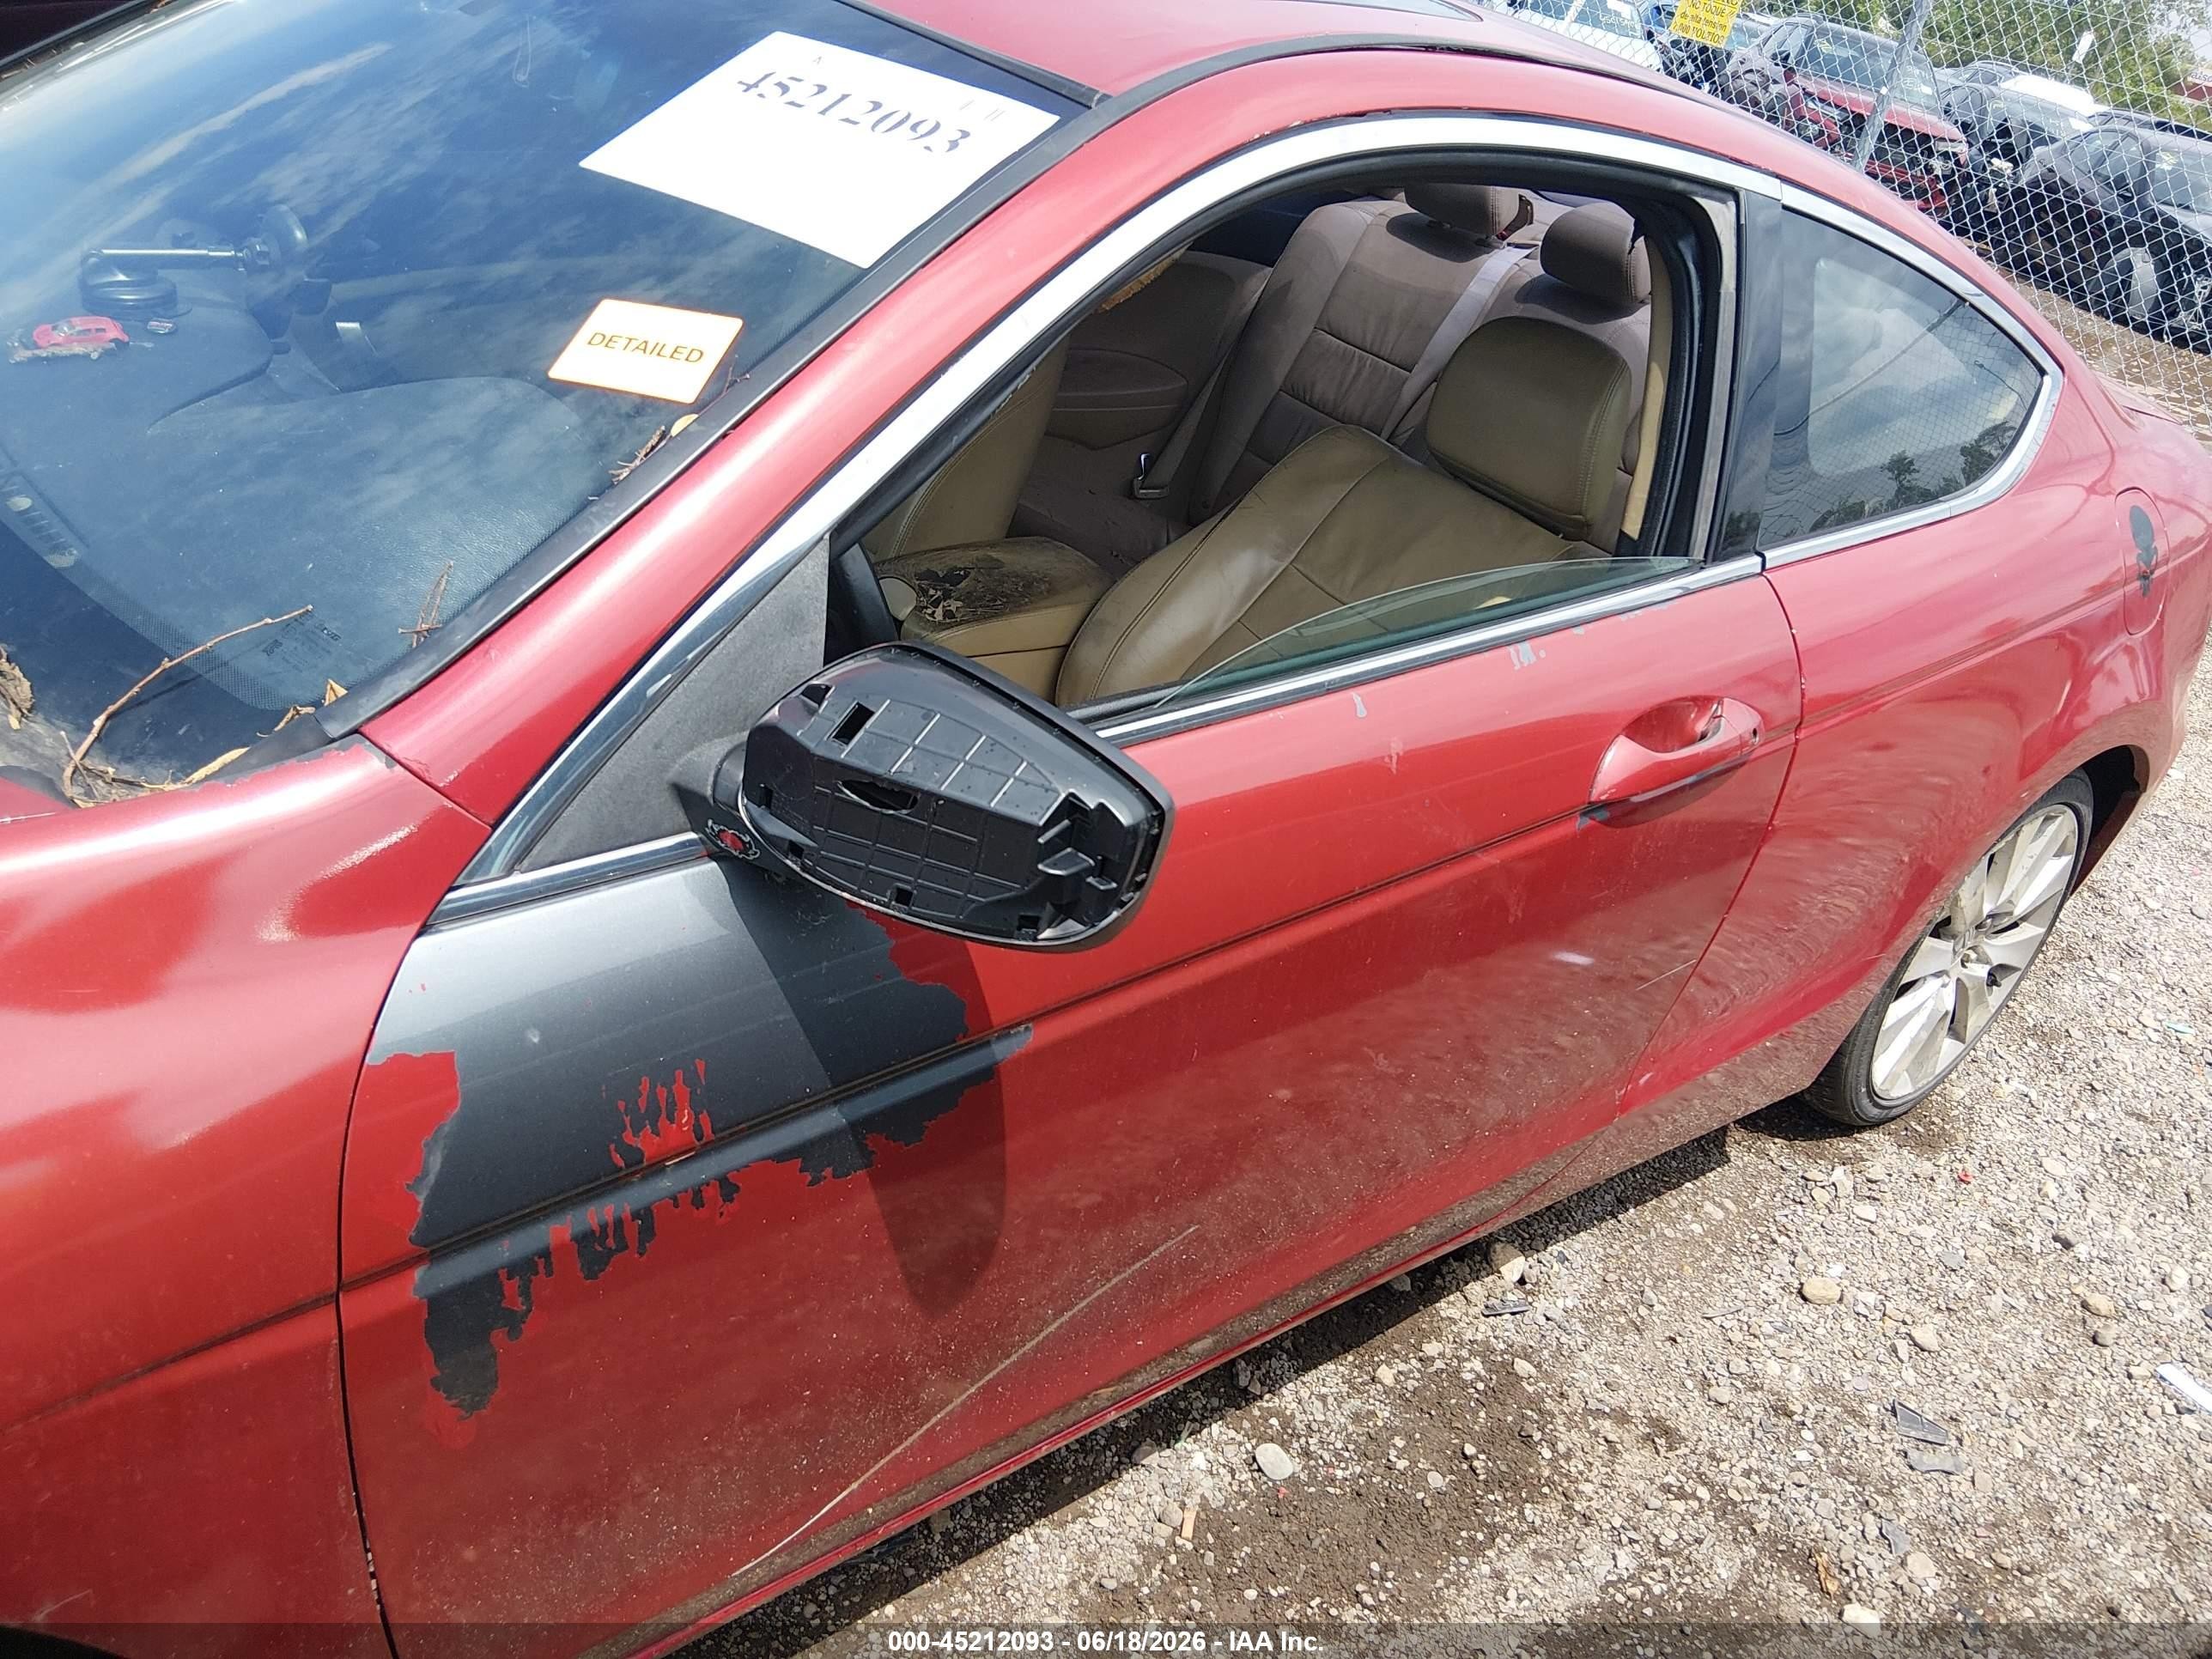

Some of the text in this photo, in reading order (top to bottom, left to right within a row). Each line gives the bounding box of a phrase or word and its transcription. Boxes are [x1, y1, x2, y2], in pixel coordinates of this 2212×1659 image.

[1680, 12, 1689, 21] de
[1689, 15, 1702, 24] alta
[1688, 0, 1701, 10] NO
[1702, 2, 1727, 18] TOQUE
[1692, 26, 1725, 45] VOLTIOS
[737, 71, 971, 153] 45212093
[586, 332, 704, 363] DETAILED
